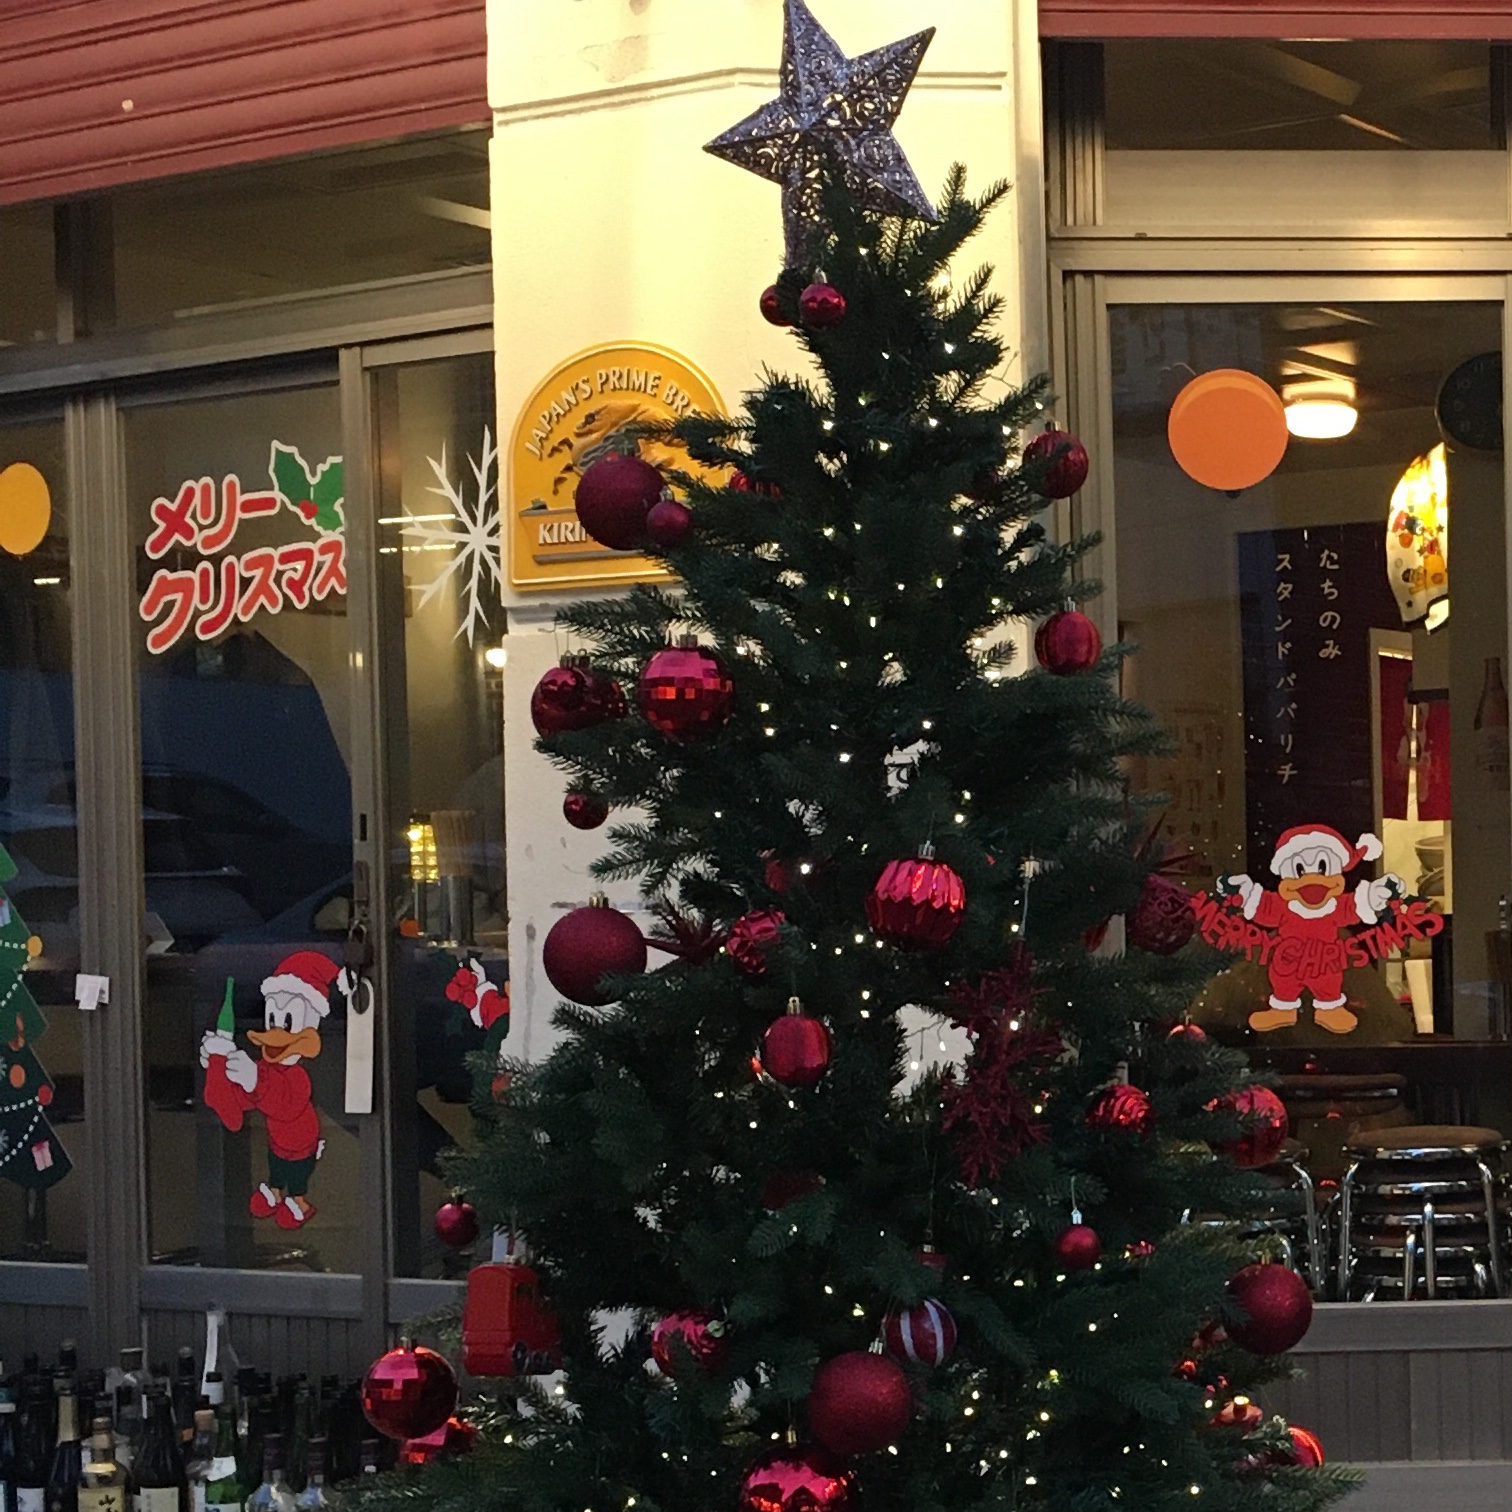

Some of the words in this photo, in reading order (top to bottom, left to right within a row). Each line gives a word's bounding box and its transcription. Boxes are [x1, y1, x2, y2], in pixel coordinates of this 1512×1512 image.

[525, 378, 595, 462] JAPAN'S
[597, 367, 662, 400] PRIME
[663, 384, 704, 420] BRE
[145, 474, 281, 560] メリー
[140, 534, 347, 654] クリスマス
[1317, 548, 1342, 660] たちのみ
[1190, 890, 1283, 966] MERRY
[1272, 902, 1445, 980] CHRISTMAS
